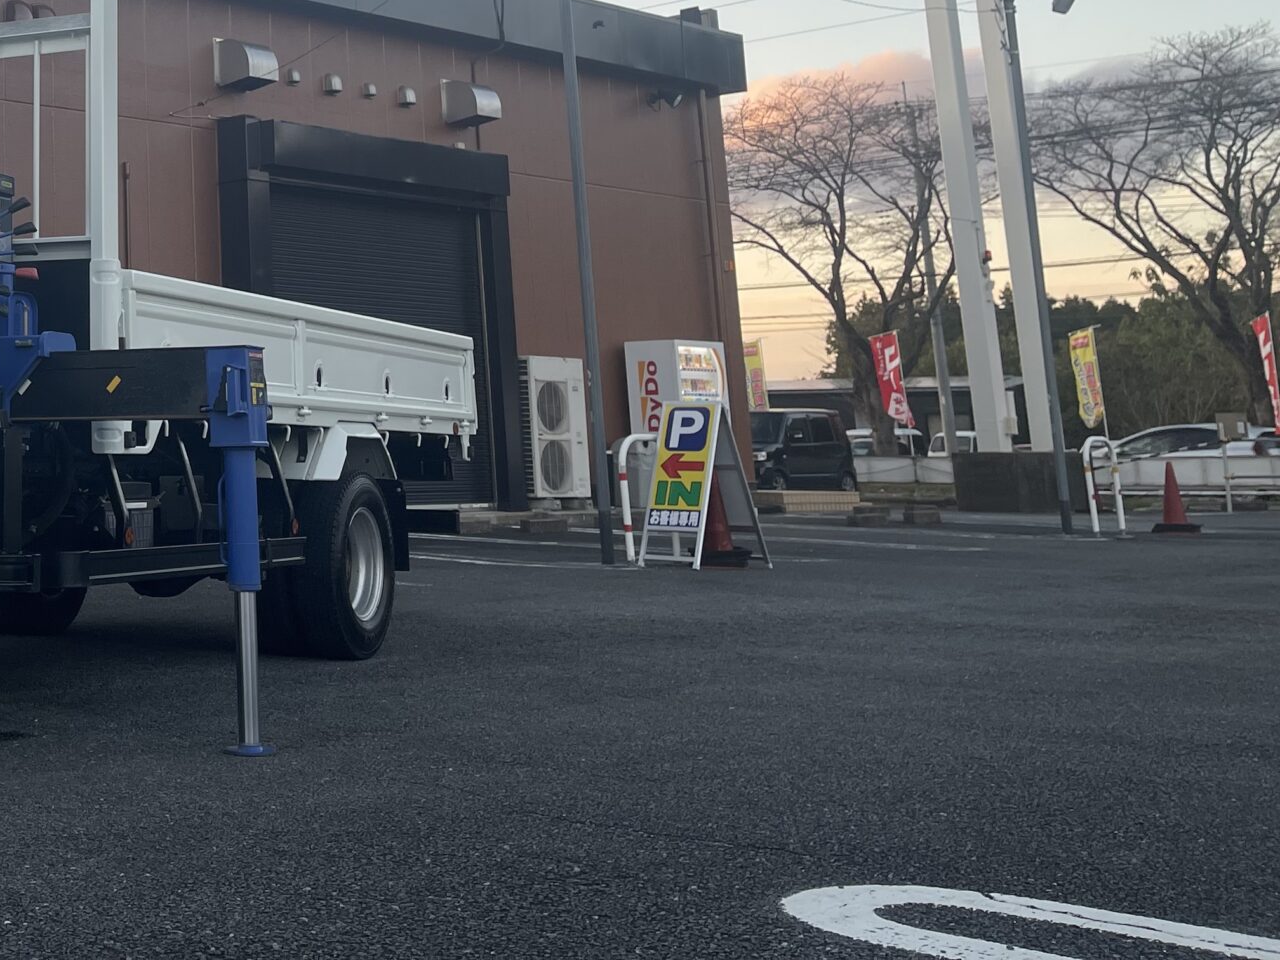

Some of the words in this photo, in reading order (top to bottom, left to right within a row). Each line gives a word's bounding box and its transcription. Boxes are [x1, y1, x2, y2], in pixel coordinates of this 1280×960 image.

[668, 410, 705, 449] P
[654, 480, 703, 507] IN
[649, 509, 700, 526] お客様専用
